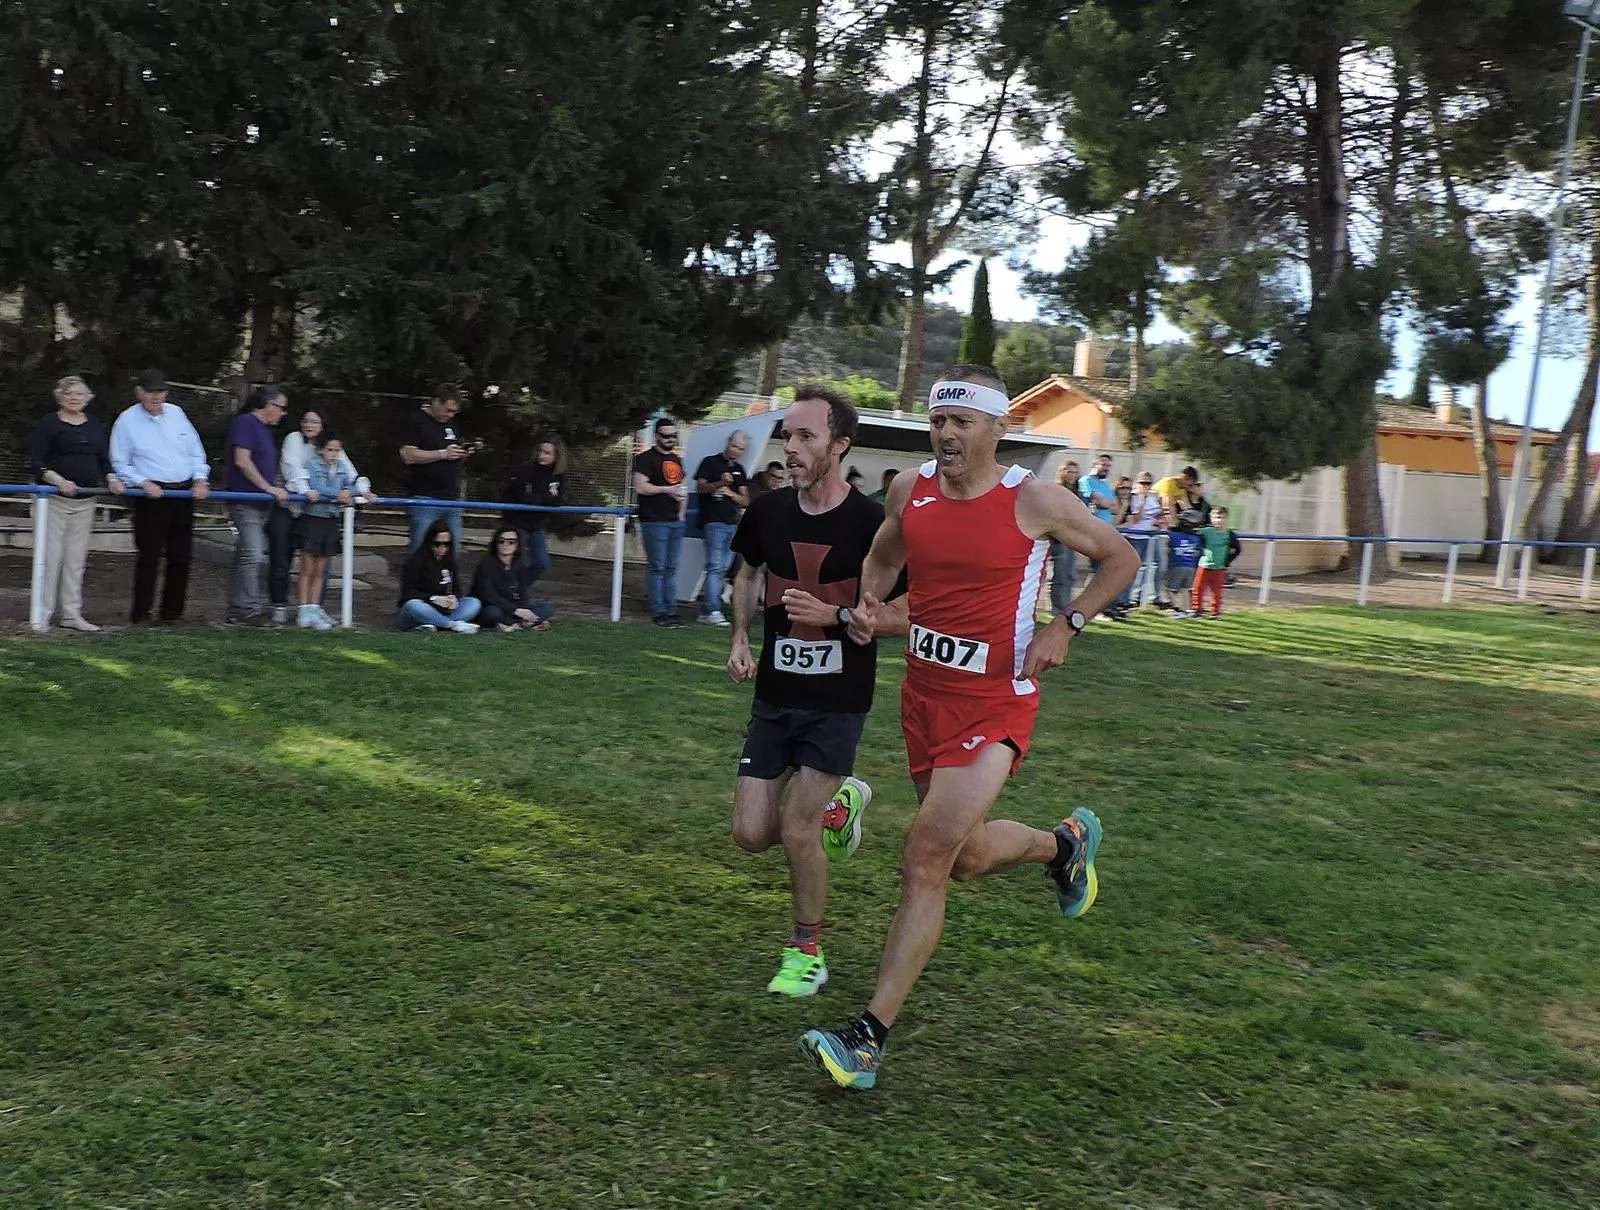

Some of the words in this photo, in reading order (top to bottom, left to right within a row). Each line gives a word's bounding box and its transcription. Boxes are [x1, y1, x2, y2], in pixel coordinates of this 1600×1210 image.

[937, 388, 966, 400] GMP
[780, 643, 833, 668] 957
[911, 628, 979, 667] 1407
